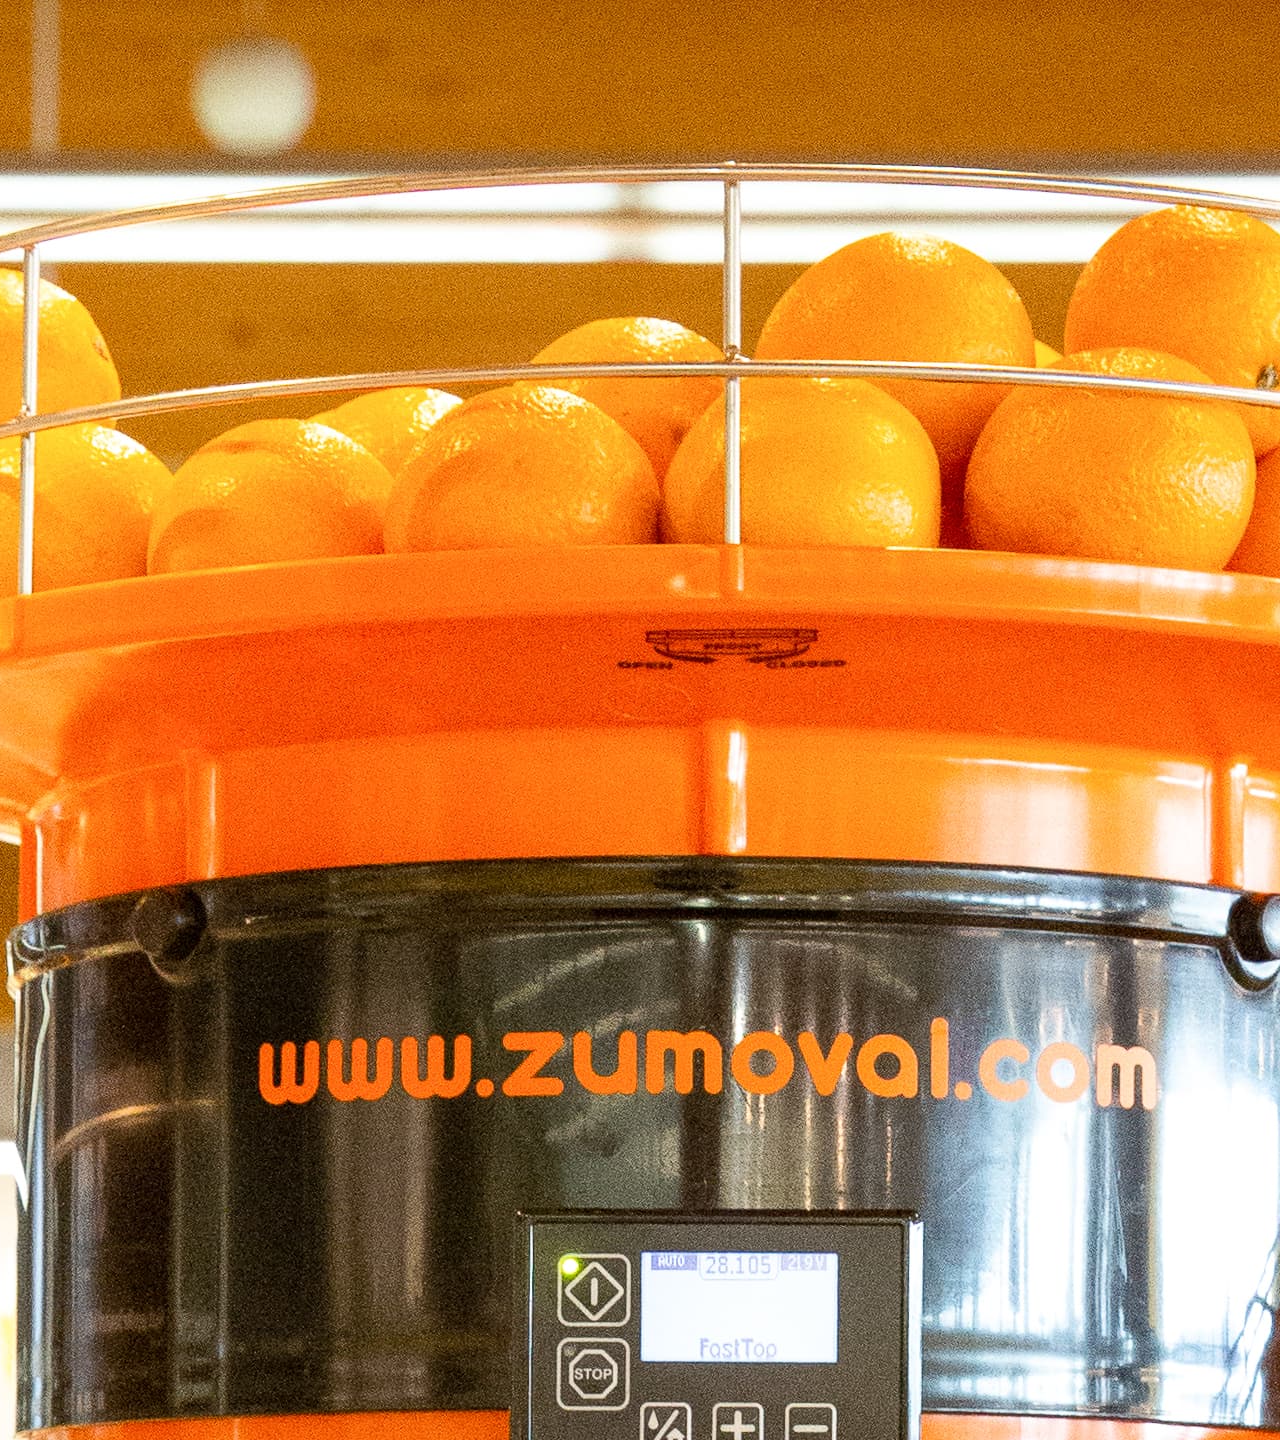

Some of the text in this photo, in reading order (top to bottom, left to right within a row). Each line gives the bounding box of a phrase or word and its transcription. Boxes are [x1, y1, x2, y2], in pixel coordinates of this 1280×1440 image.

[258, 1017, 1159, 1111] www.zumoval.com
[705, 1255, 772, 1275] 28.105
[699, 1338, 777, 1360] FastTop
[574, 1369, 613, 1380] STOP
